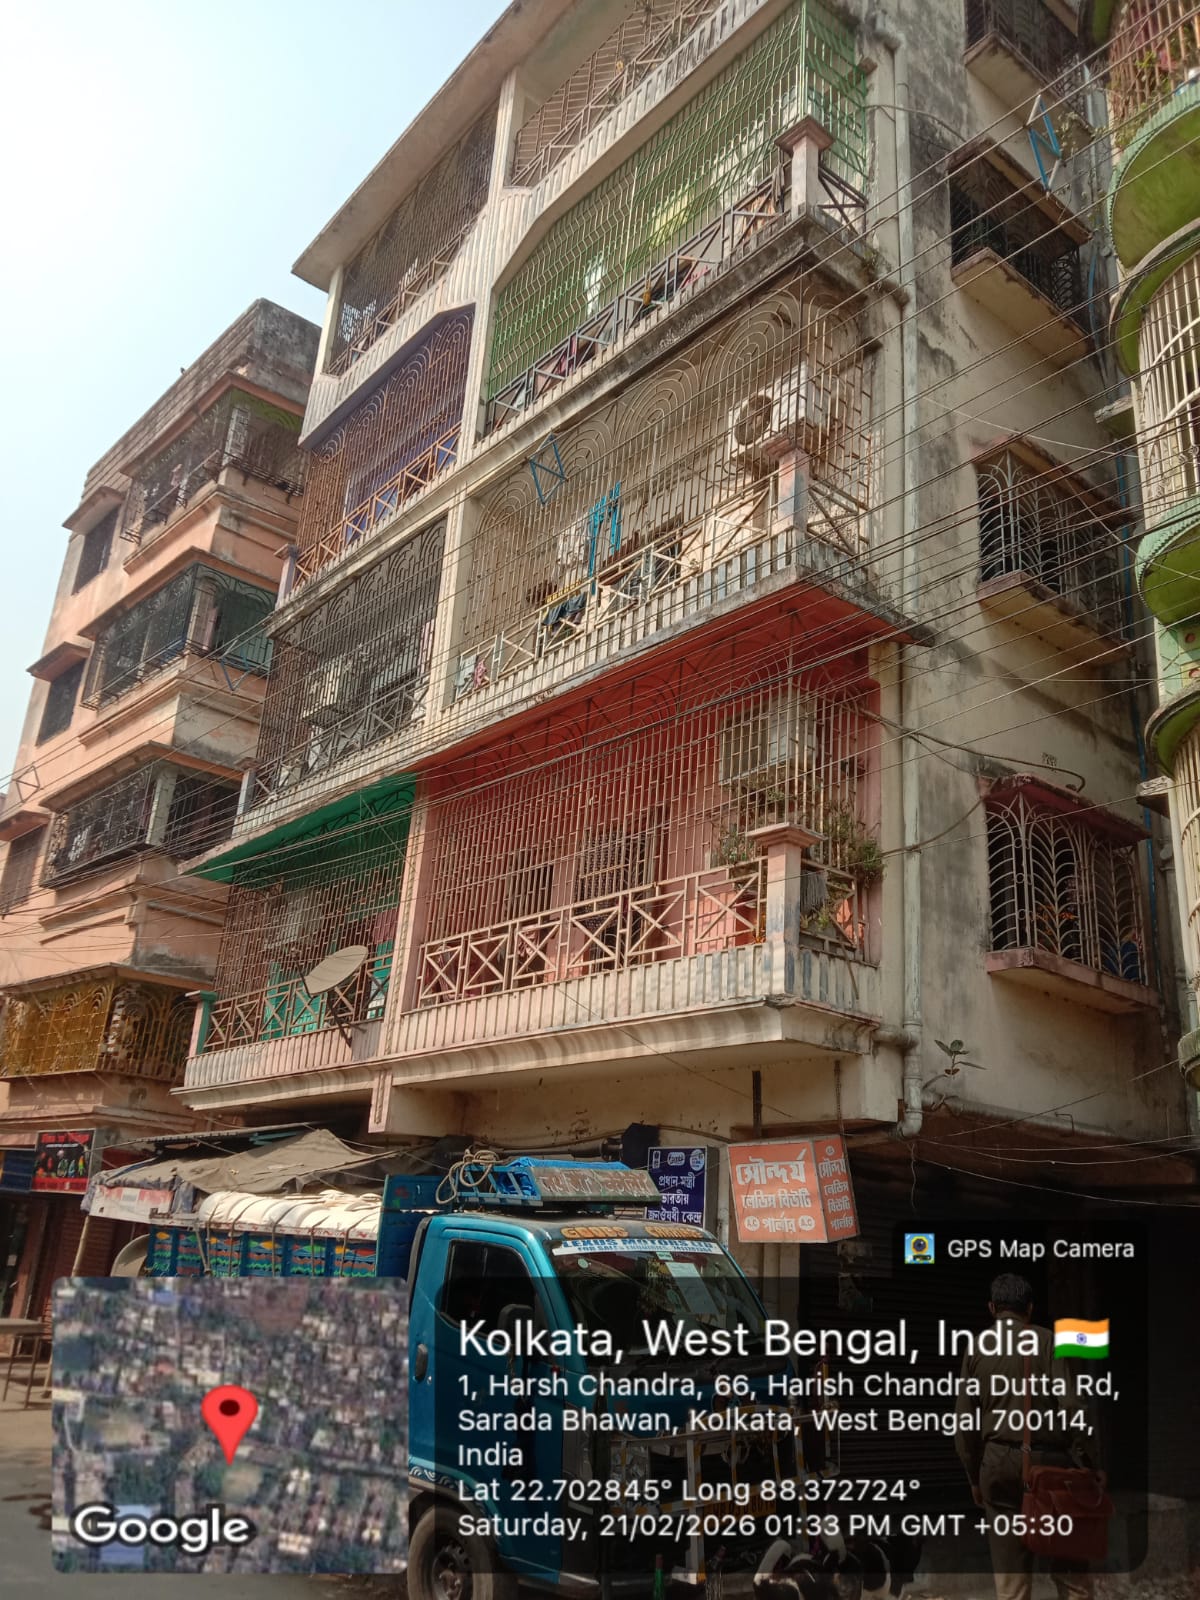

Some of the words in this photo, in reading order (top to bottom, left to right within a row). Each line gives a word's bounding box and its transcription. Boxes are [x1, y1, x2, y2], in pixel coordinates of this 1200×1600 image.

[736, 1148, 807, 1185] সৌন্দর্য
[658, 1174, 678, 1188] প্রধান
[741, 1189, 777, 1209] লেডিস
[777, 1188, 812, 1209] বিউটি
[762, 1211, 796, 1233] পার্লার
[560, 1226, 630, 1239] GOODS
[562, 1238, 618, 1248] LEXUS
